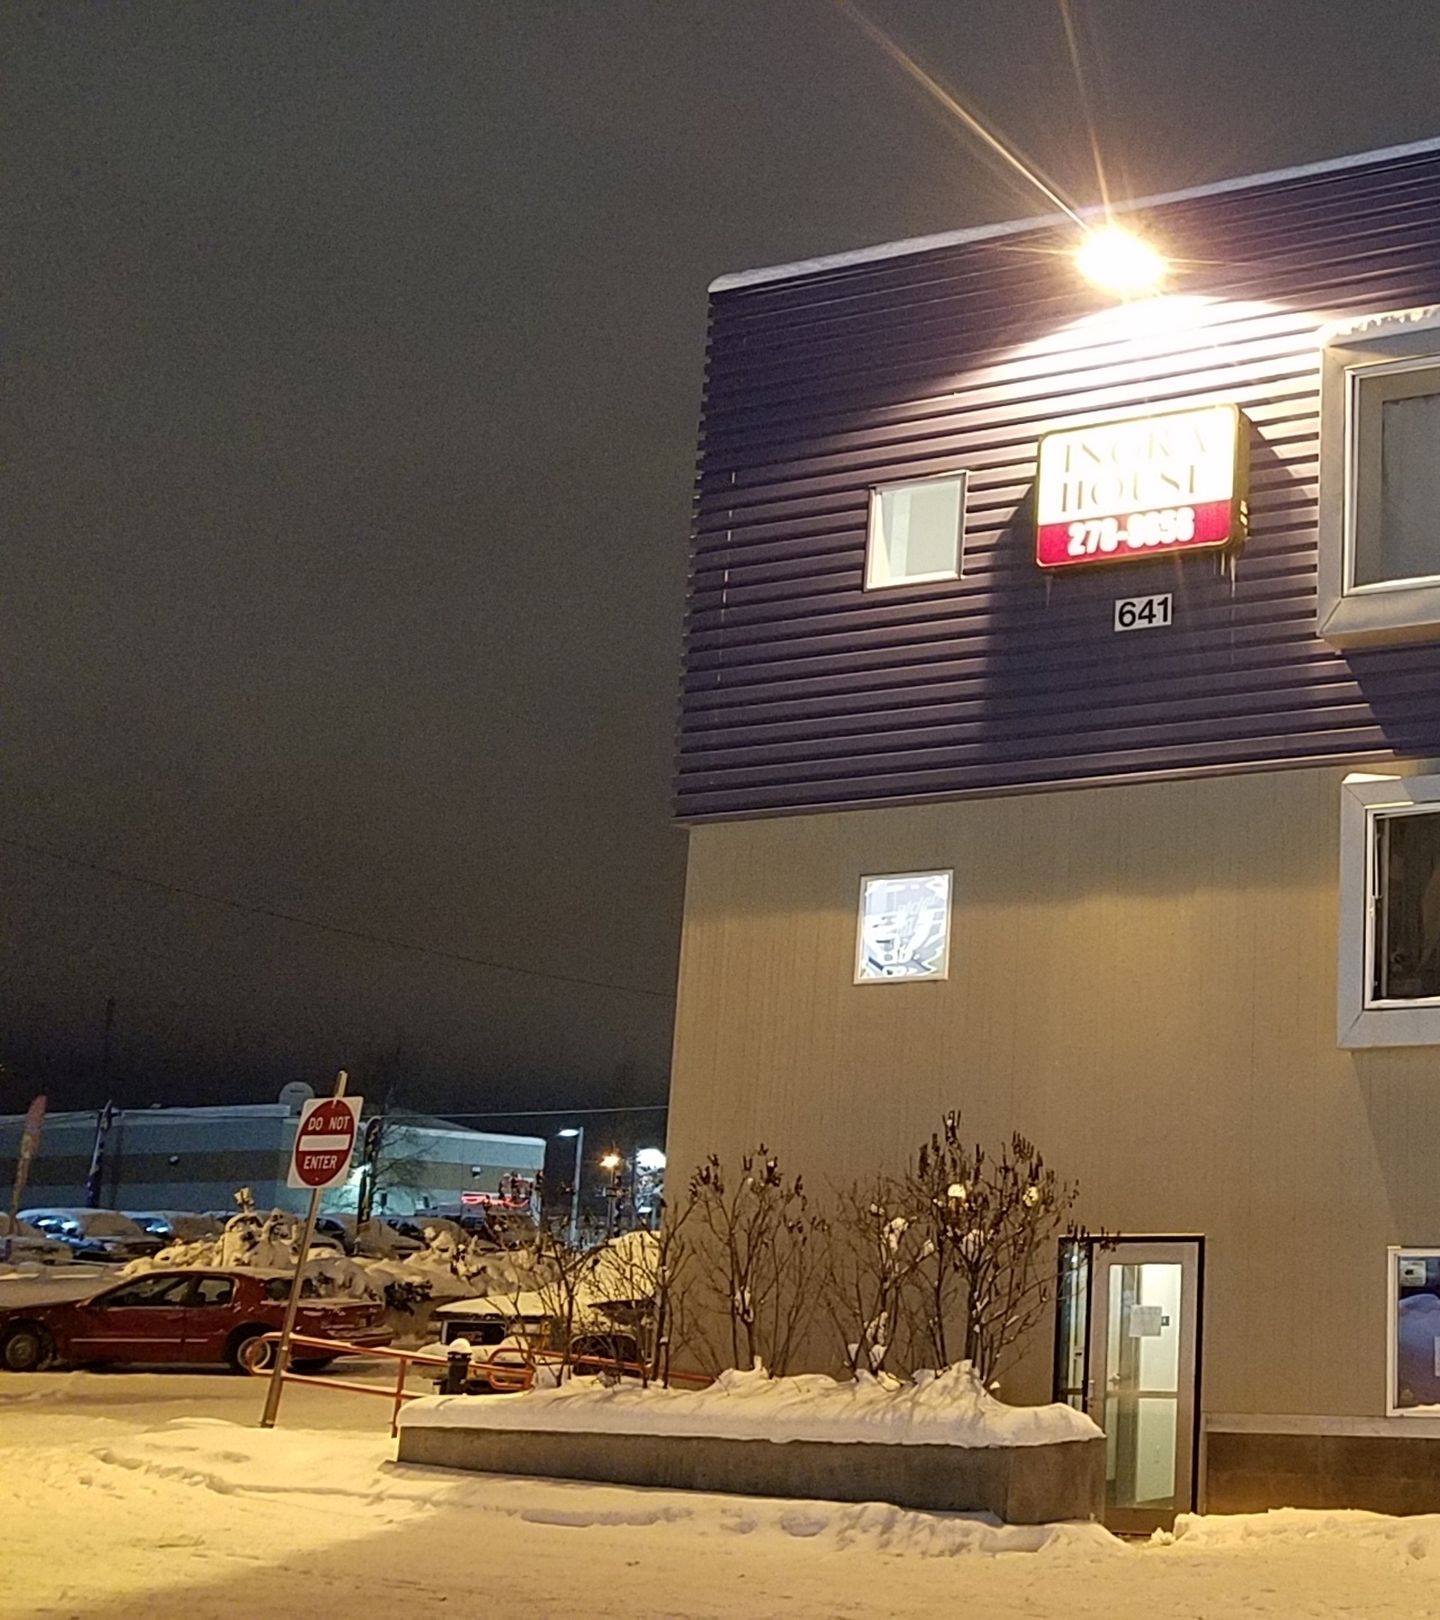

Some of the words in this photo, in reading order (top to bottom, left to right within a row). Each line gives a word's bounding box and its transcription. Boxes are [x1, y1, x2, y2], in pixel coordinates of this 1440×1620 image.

[1118, 597, 1170, 627] 641
[308, 1117, 324, 1131] DO
[329, 1116, 351, 1130] NOT
[304, 1156, 338, 1170] ENTER
